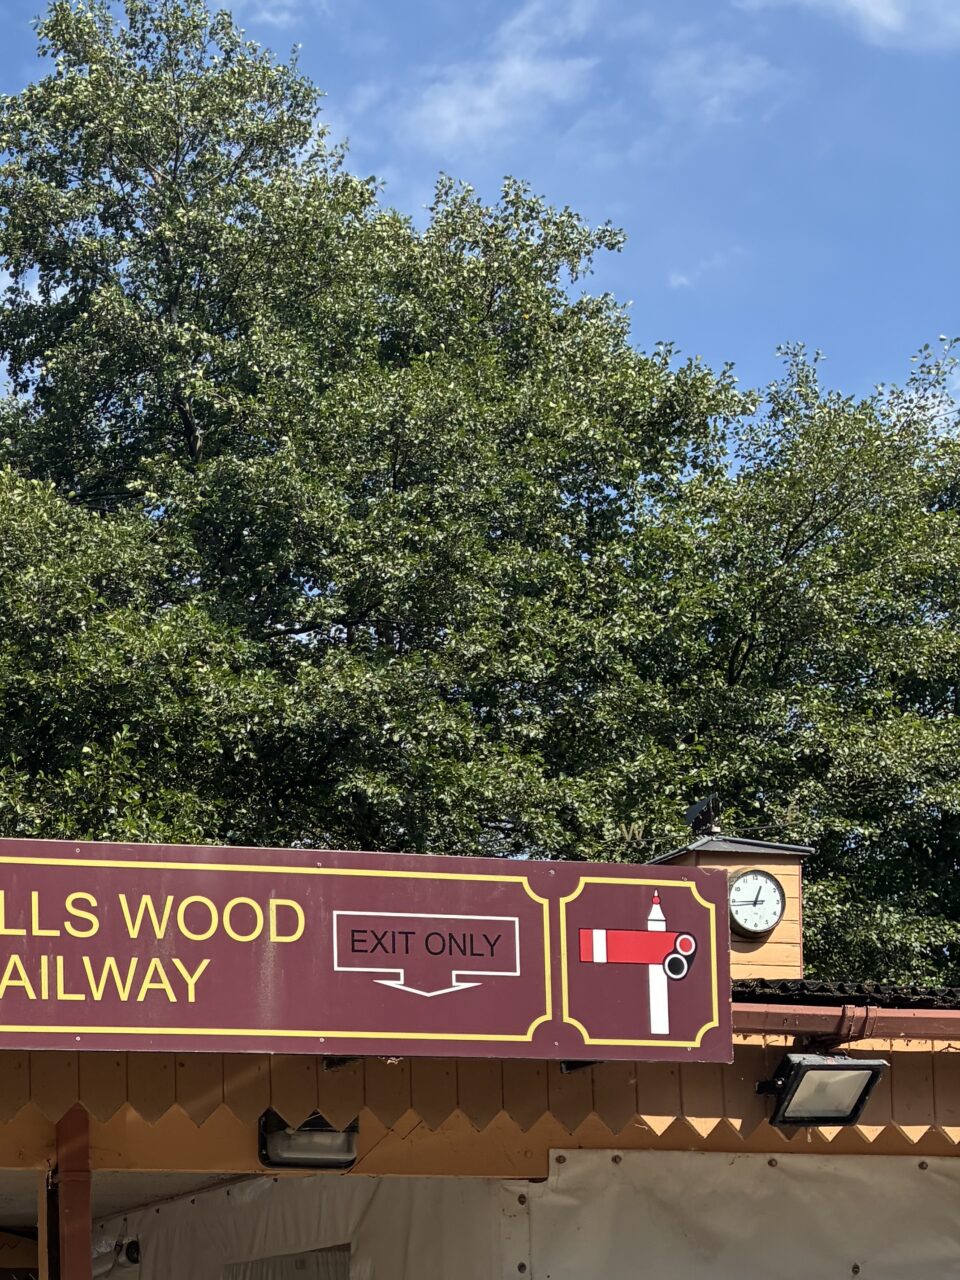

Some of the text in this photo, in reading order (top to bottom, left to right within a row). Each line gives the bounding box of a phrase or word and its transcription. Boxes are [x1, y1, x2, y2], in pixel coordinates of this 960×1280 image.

[118, 894, 306, 943] WOOD
[351, 929, 502, 957] EXIT ONLY
